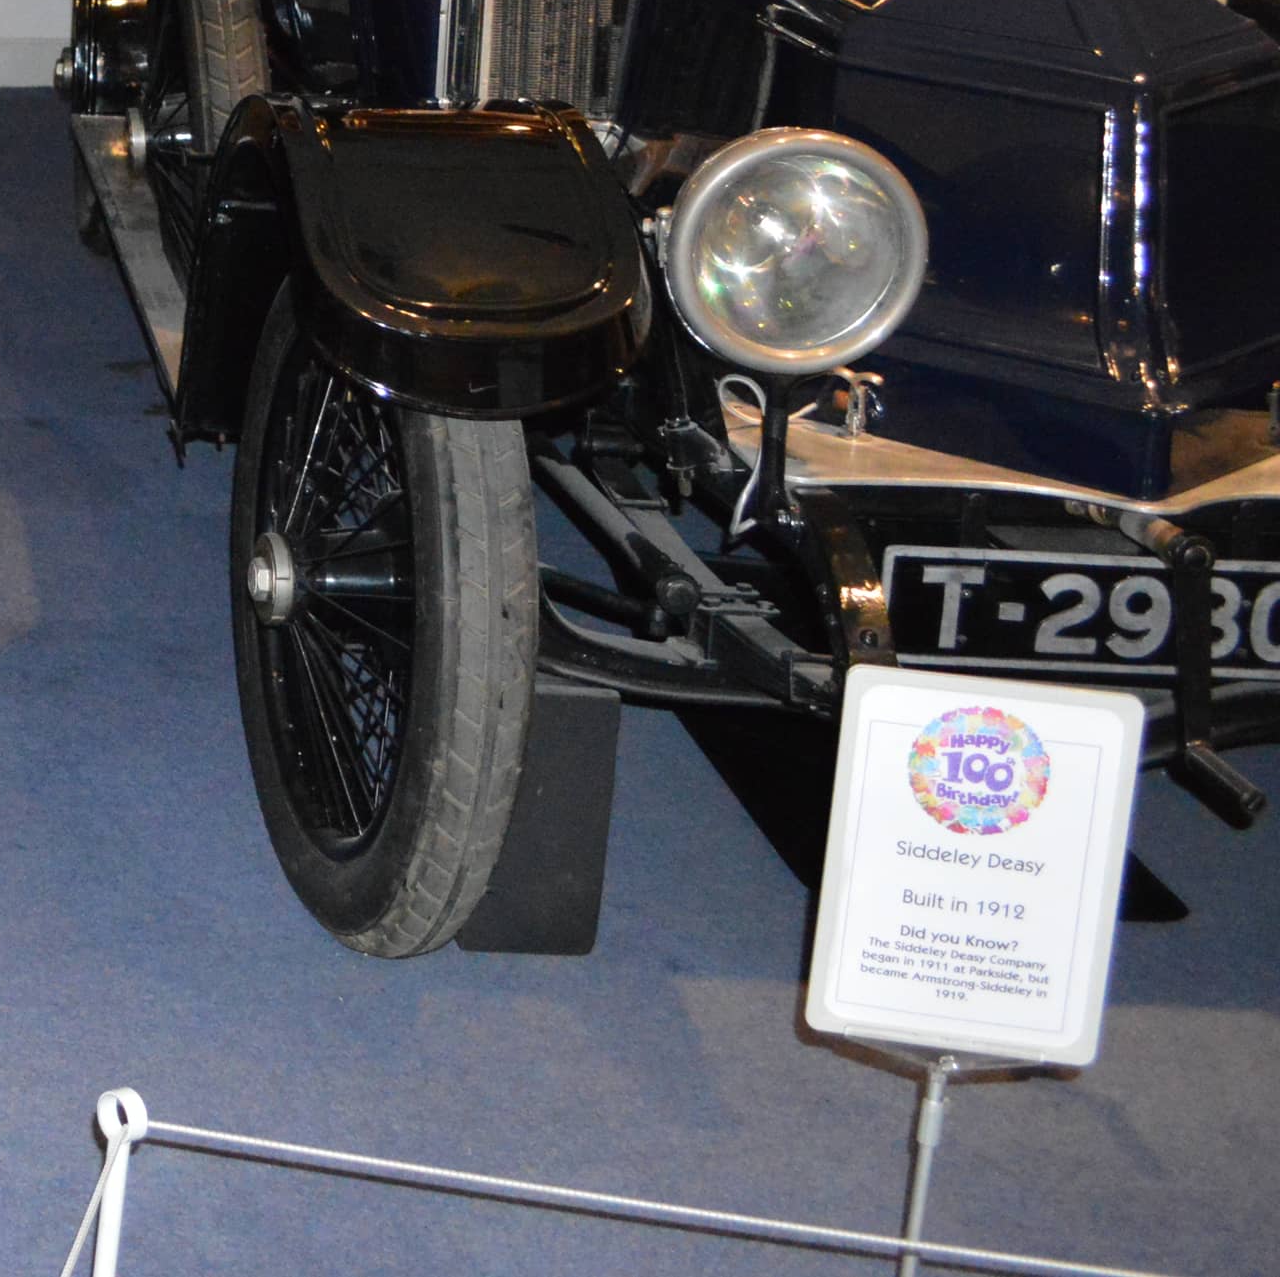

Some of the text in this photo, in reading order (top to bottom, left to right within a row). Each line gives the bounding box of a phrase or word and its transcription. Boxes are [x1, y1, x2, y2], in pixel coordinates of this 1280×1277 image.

[950, 733, 1011, 756] Happy
[935, 782, 1020, 809] Birthday!
[895, 839, 1046, 877] Siddeley Deasy
[902, 888, 1026, 921] Built in 1912
[869, 936, 1047, 972] The Siddeley Deasy Company
[899, 924, 1019, 952] Did you Know?
[860, 962, 1048, 999] became Armstrong-Siddeley in
[861, 949, 1050, 986] began in 1911 at Parkside, but
[935, 988, 969, 1002] 1919.
